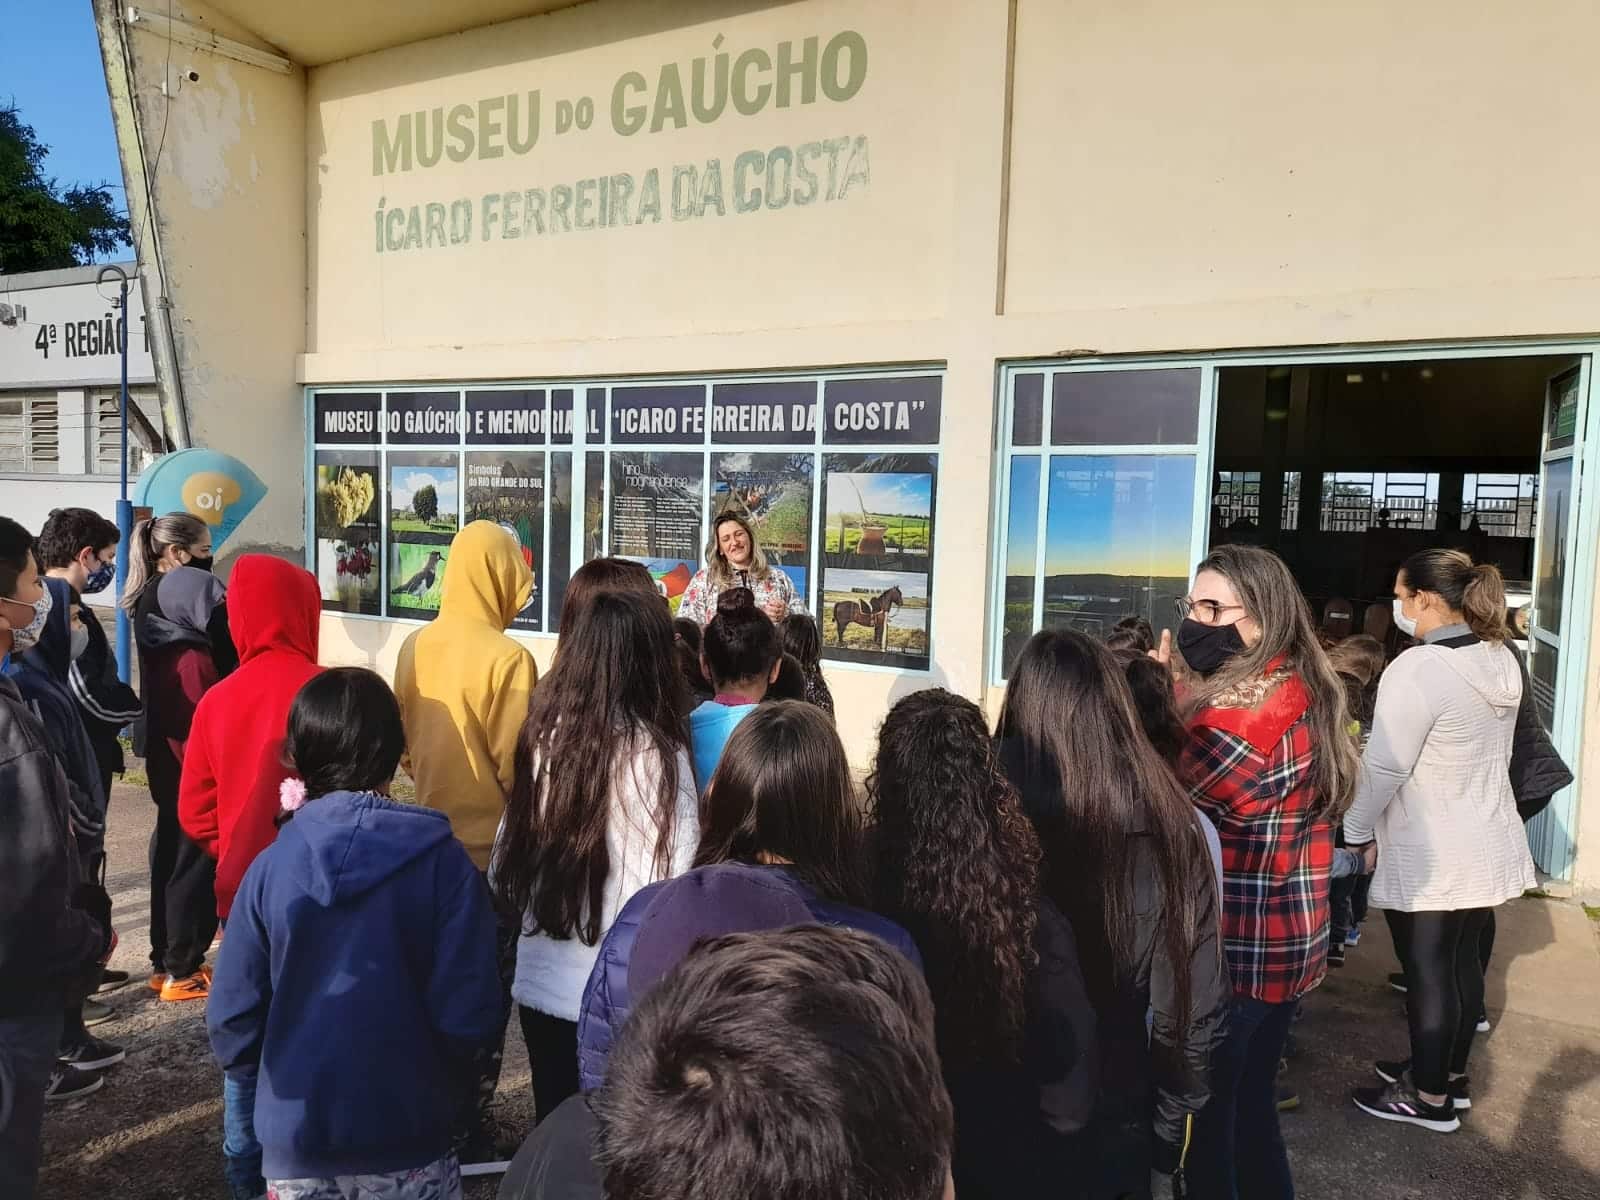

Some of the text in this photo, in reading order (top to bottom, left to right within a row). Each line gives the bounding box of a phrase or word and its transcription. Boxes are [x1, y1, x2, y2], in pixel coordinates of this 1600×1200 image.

[372, 30, 868, 177] MUSEU DO GAÚCHO
[375, 134, 870, 253] ÍCARO FERREIRA DA COSTA
[324, 410, 373, 433] MUSEU
[377, 410, 400, 433] DO
[404, 406, 471, 434] GAÚCHO
[475, 410, 484, 434] E
[488, 408, 599, 434] MEMORIAL
[682, 404, 785, 433] FERREIRA
[792, 404, 827, 432] DA
[478, 477, 490, 488] RIO
[491, 477, 518, 489] GRANDE
[519, 478, 529, 489] DO
[529, 478, 543, 490] SUL
